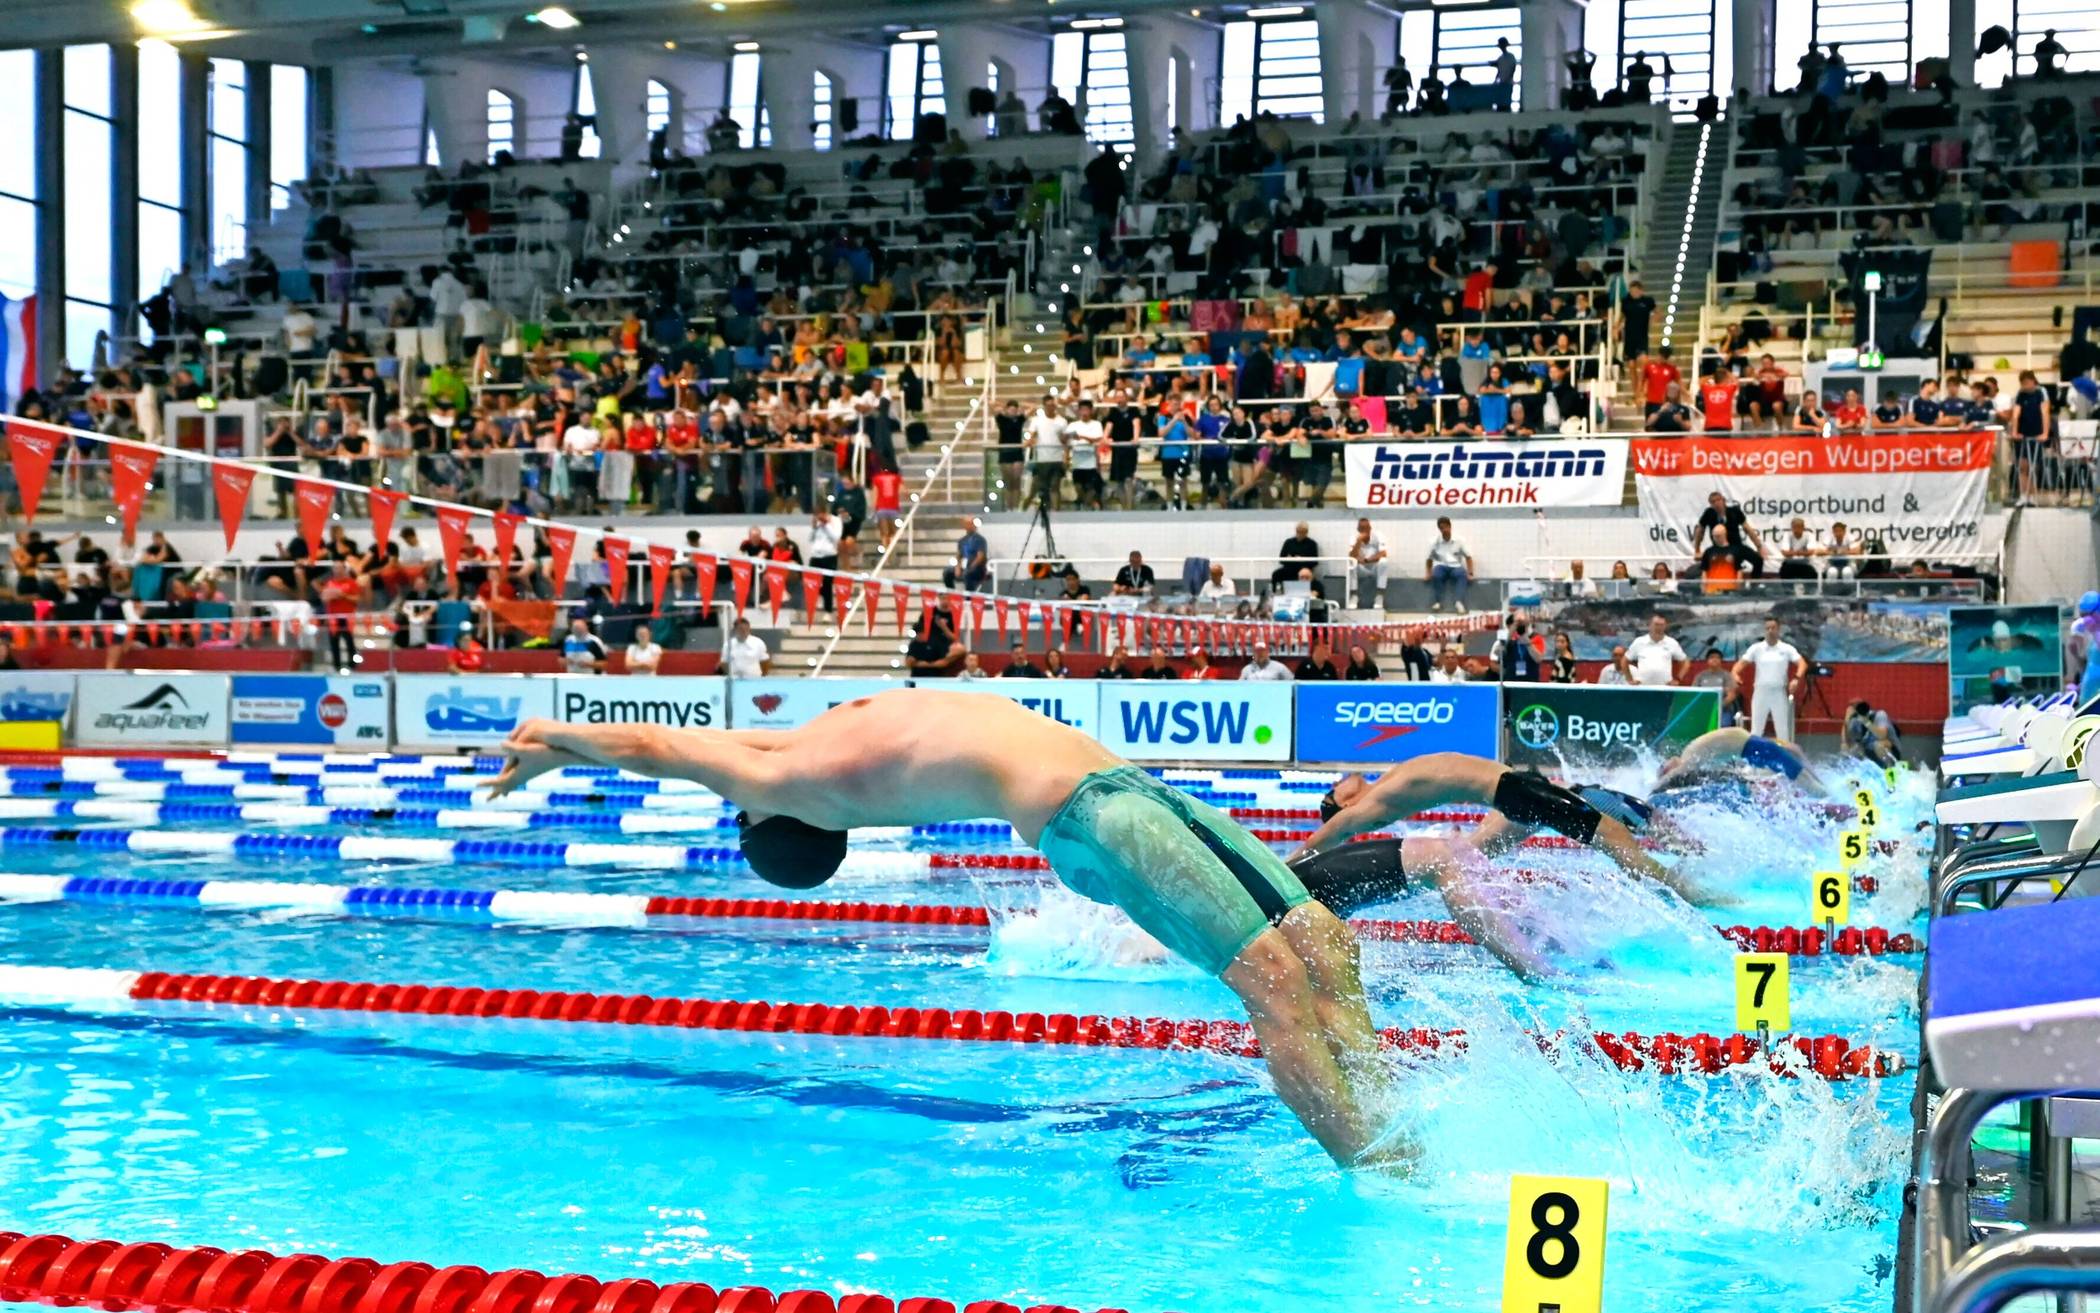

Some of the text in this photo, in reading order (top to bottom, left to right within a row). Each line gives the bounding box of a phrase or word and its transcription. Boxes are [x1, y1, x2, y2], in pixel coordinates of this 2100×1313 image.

[1371, 445, 1606, 480] hartmann
[1636, 447, 1682, 470] Wir
[1692, 446, 1813, 474] bewegen
[1825, 441, 1972, 472] Wuppertal
[1367, 482, 1539, 506] Bürotechnik
[1903, 492, 1920, 513] &
[1650, 523, 1678, 542] die
[94, 711, 210, 734] aquafeel
[565, 692, 712, 728] Pammys
[1335, 697, 1455, 728] speedo
[1567, 714, 1643, 748] Bayer
[1857, 791, 1870, 807] 3
[1845, 834, 1862, 859] 5
[1819, 877, 1842, 908] 6
[1746, 962, 1777, 1008] 7
[1526, 1192, 1580, 1280] 8
